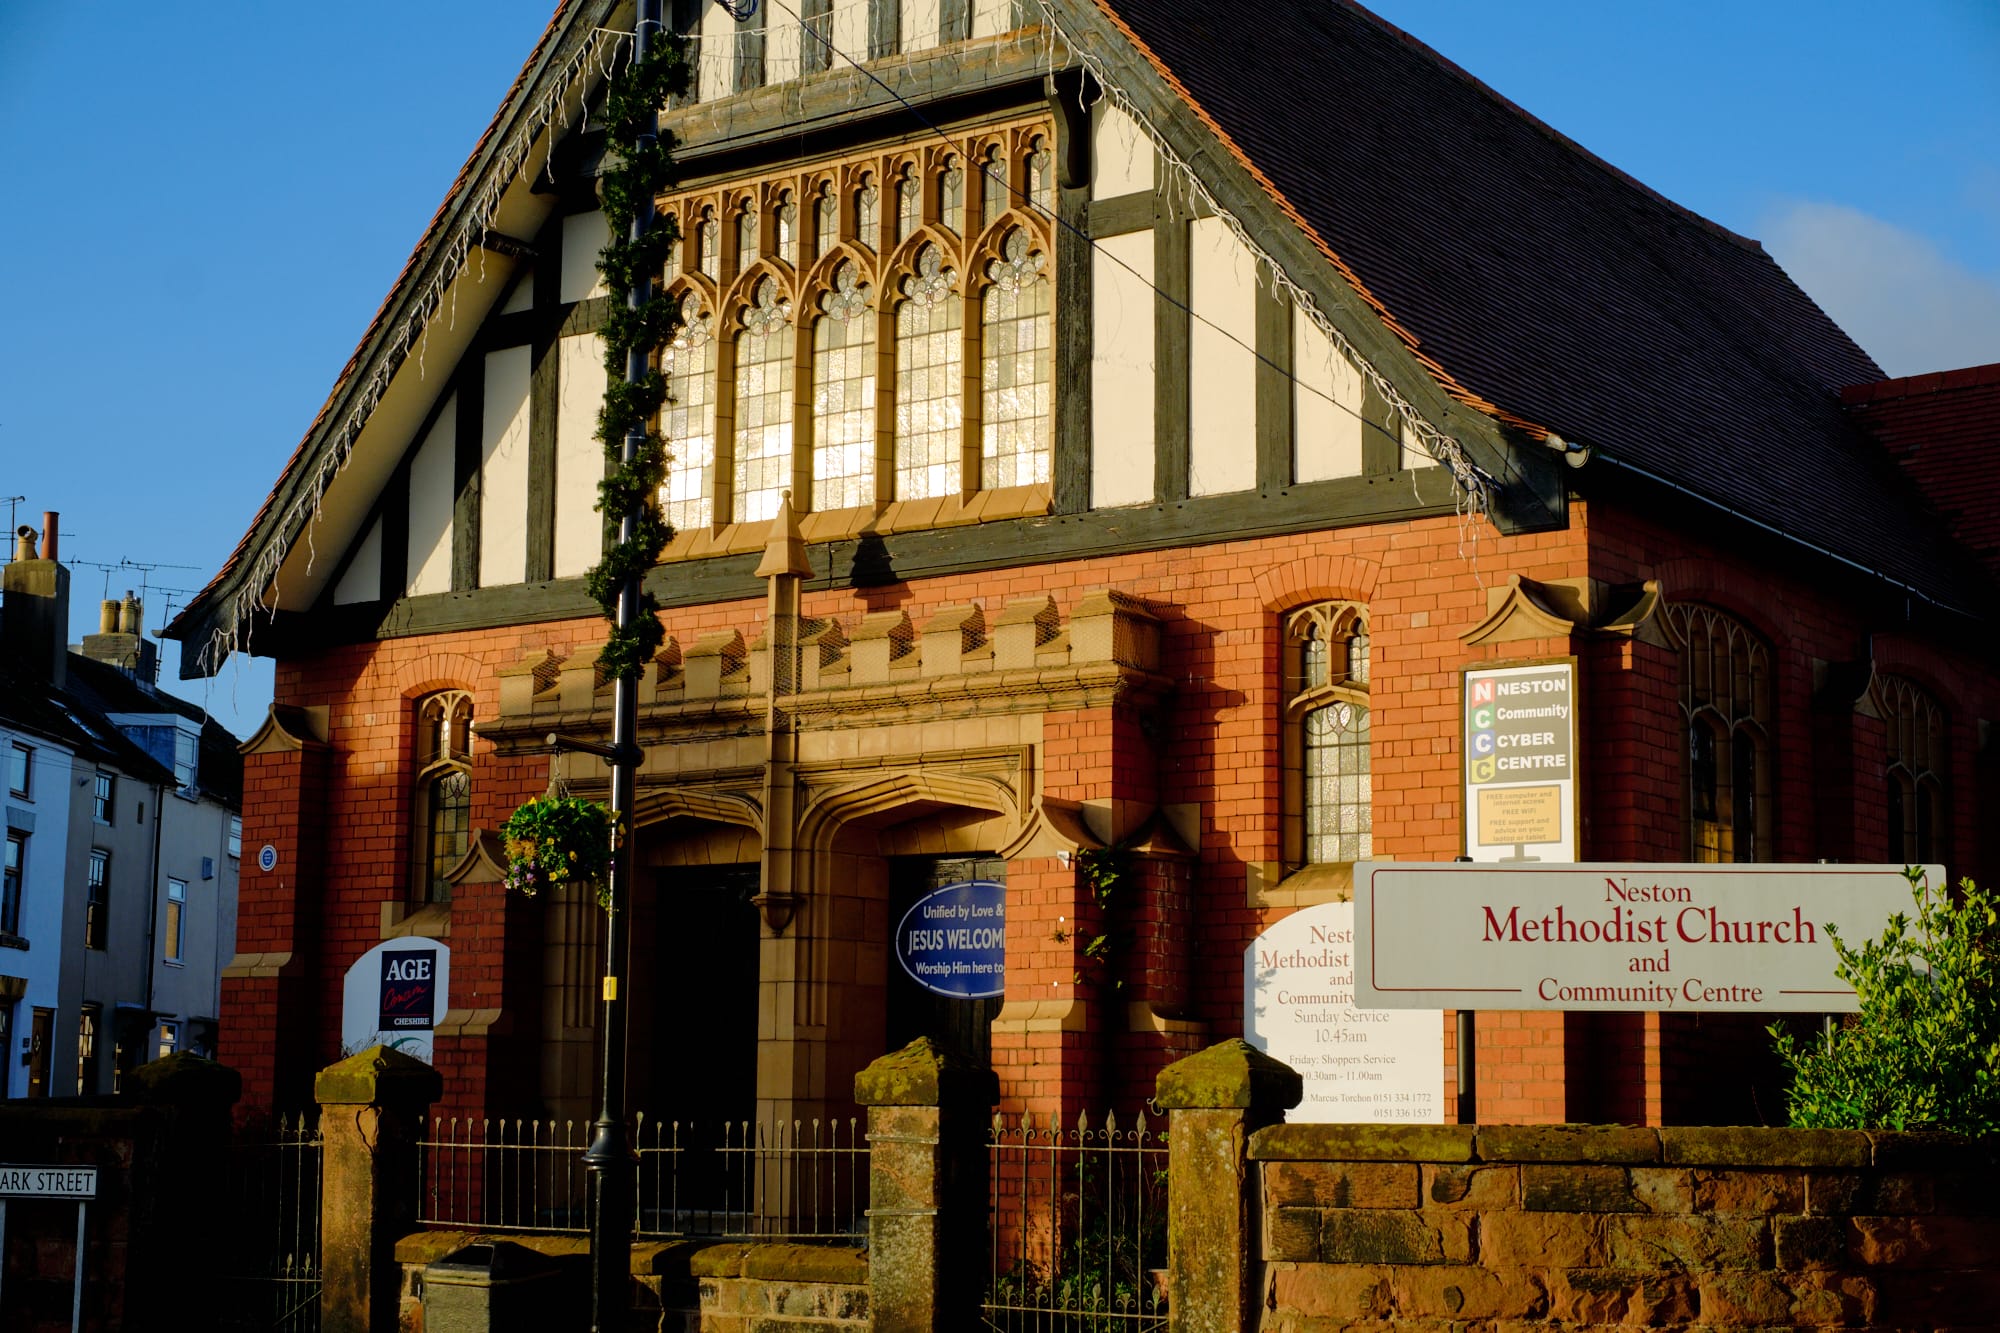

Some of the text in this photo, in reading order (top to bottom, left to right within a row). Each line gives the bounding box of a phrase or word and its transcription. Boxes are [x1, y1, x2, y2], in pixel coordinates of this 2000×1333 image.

[1497, 679, 1566, 696] NESTON
[1497, 704, 1568, 720] Community
[1497, 732, 1555, 748] CYBER
[1497, 754, 1566, 770] CENTRE
[1605, 878, 1692, 903] Neston
[923, 905, 955, 919] Unified
[958, 904, 969, 921] by
[972, 904, 993, 917] Love
[1482, 905, 1818, 944] Methodist Church
[908, 929, 944, 955] JESUS
[1310, 925, 1354, 944] Nest
[1261, 948, 1350, 969] Methodist
[1628, 949, 1670, 973] and
[386, 959, 431, 981] AGE
[915, 960, 1005, 977] Worship Him here to
[1329, 971, 1353, 985] and
[1538, 978, 1763, 1008] Community Centre
[394, 1017, 430, 1026] CHESHIRE
[1294, 1008, 1390, 1026] Sunday Service
[1315, 1028, 1367, 1043] 10.45am
[1289, 1055, 1396, 1067] Friday: Shoppers Service
[1346, 1071, 1382, 1081] 11.00am
[1310, 1094, 1338, 1103] Marcus
[1373, 1093, 1392, 1102] 0151
[1374, 1108, 1392, 1118] 0151
[37, 1172, 94, 1191] STREET
